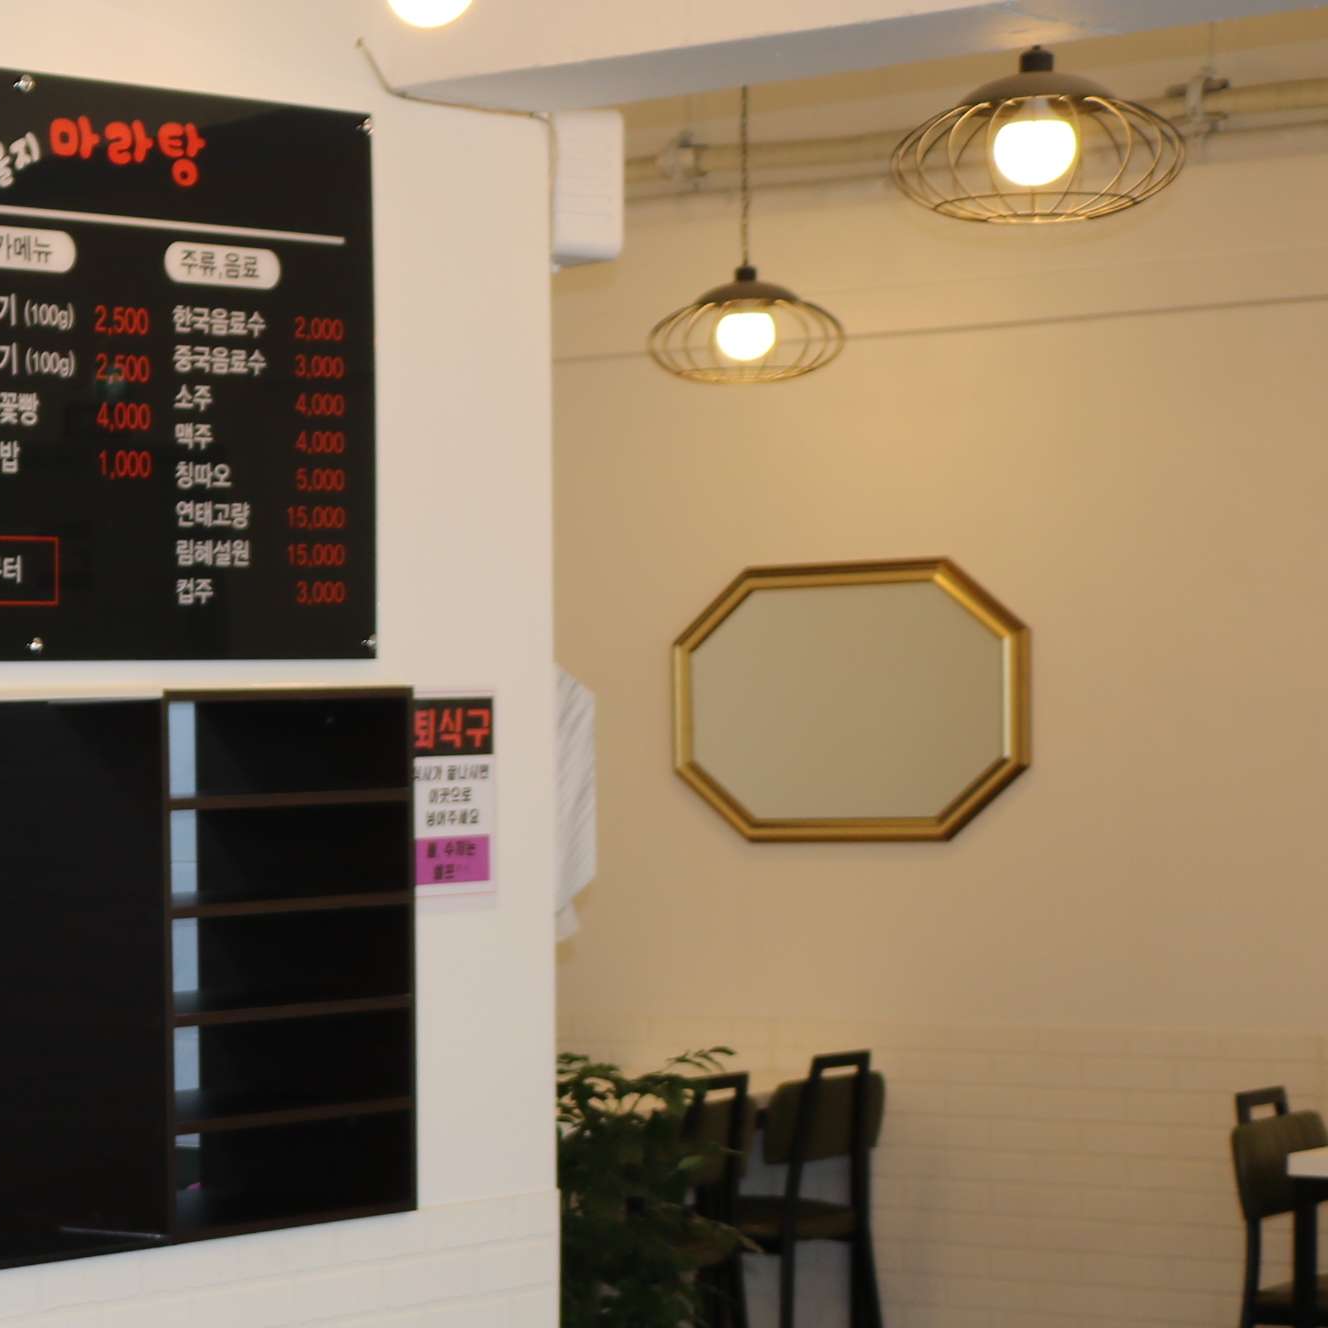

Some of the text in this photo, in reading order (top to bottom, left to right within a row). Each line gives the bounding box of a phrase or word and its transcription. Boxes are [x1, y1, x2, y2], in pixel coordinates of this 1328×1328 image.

[48, 115, 207, 188] 마라탕
[23, 299, 75, 331] (100g)
[94, 304, 151, 337] 2,500
[172, 304, 267, 338] 한국음료수
[25, 347, 76, 378] (100g)
[95, 351, 153, 385] 2,500
[172, 344, 267, 376] 중국음료수
[173, 383, 213, 412] 소주
[95, 401, 153, 432] 4,000
[174, 422, 214, 450] 맥주
[98, 449, 154, 480] 1,000
[175, 460, 232, 490] 칭따오
[175, 500, 251, 530] 연태고량
[176, 577, 214, 606] 컵주
[413, 707, 491, 750] 퇴식구
